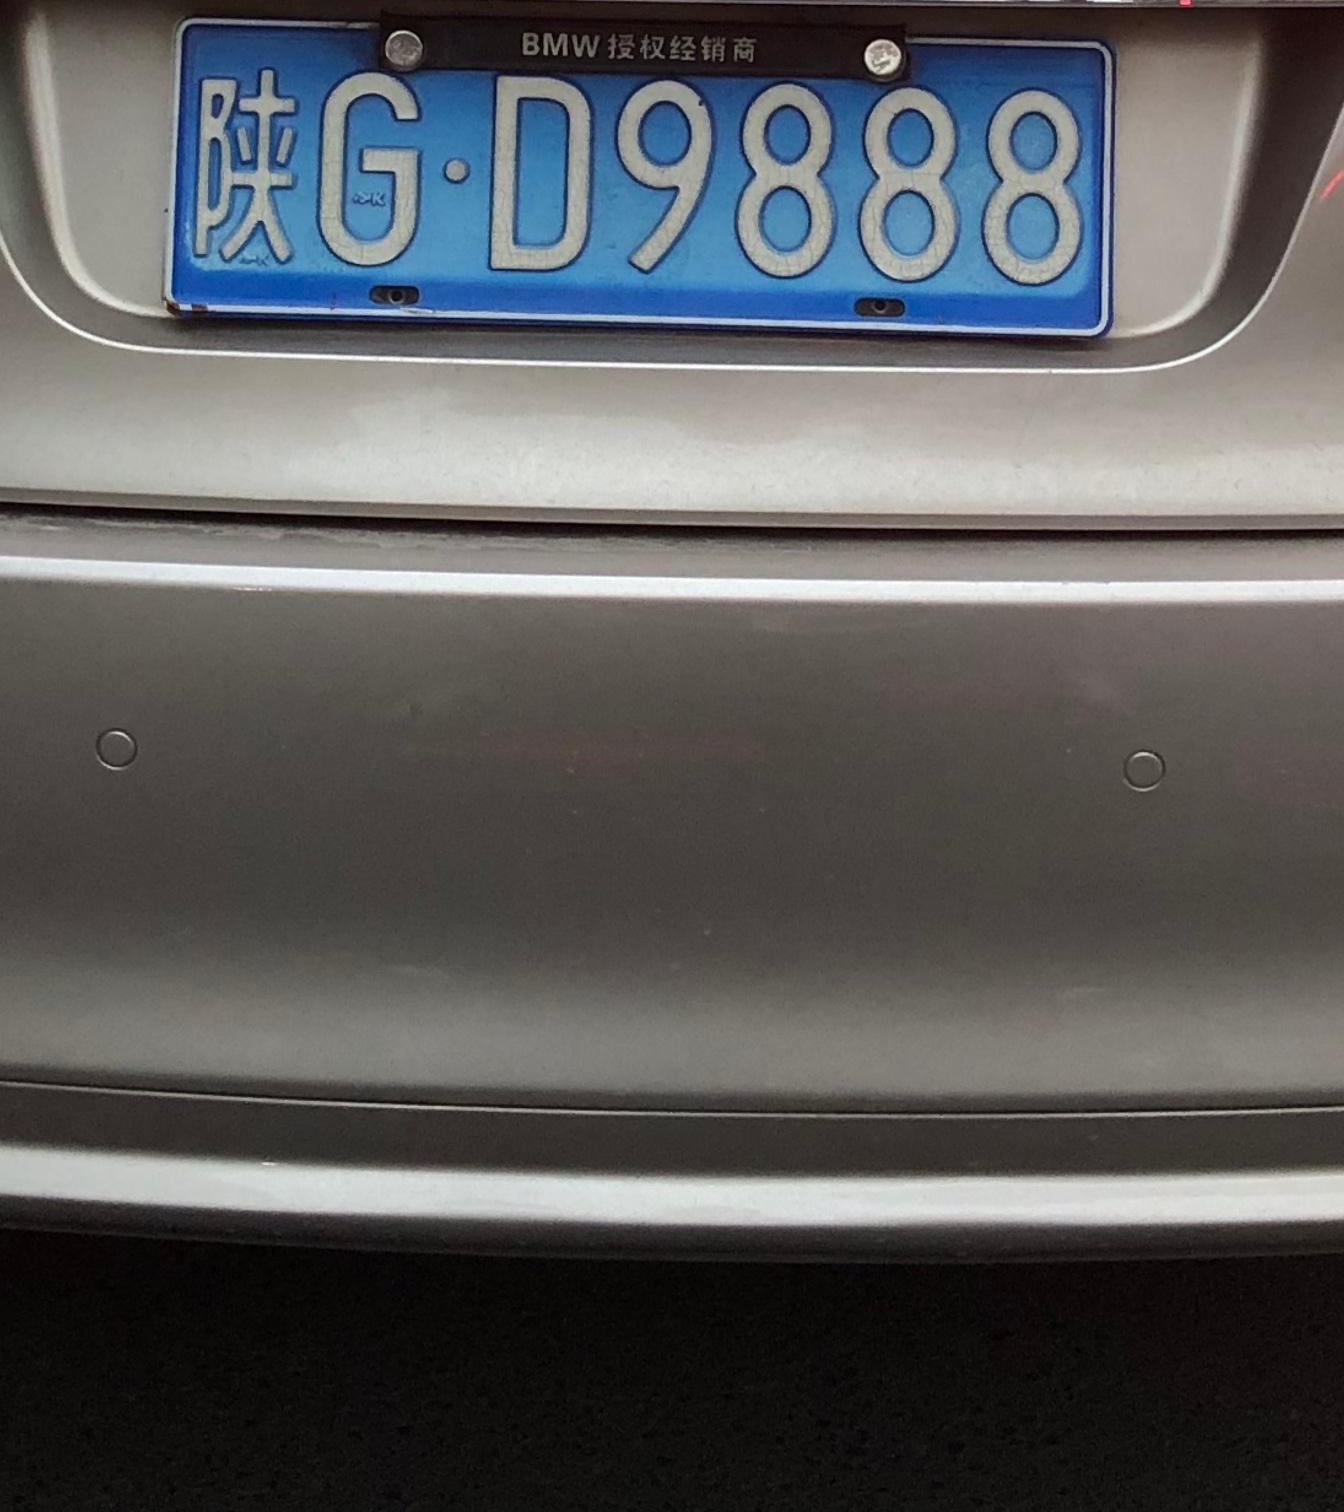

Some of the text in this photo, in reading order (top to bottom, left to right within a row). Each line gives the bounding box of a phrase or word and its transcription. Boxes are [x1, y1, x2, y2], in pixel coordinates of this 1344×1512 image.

[522, 32, 757, 63] BMW 授权经销商
[193, 69, 1084, 285] 陕G·D9888
